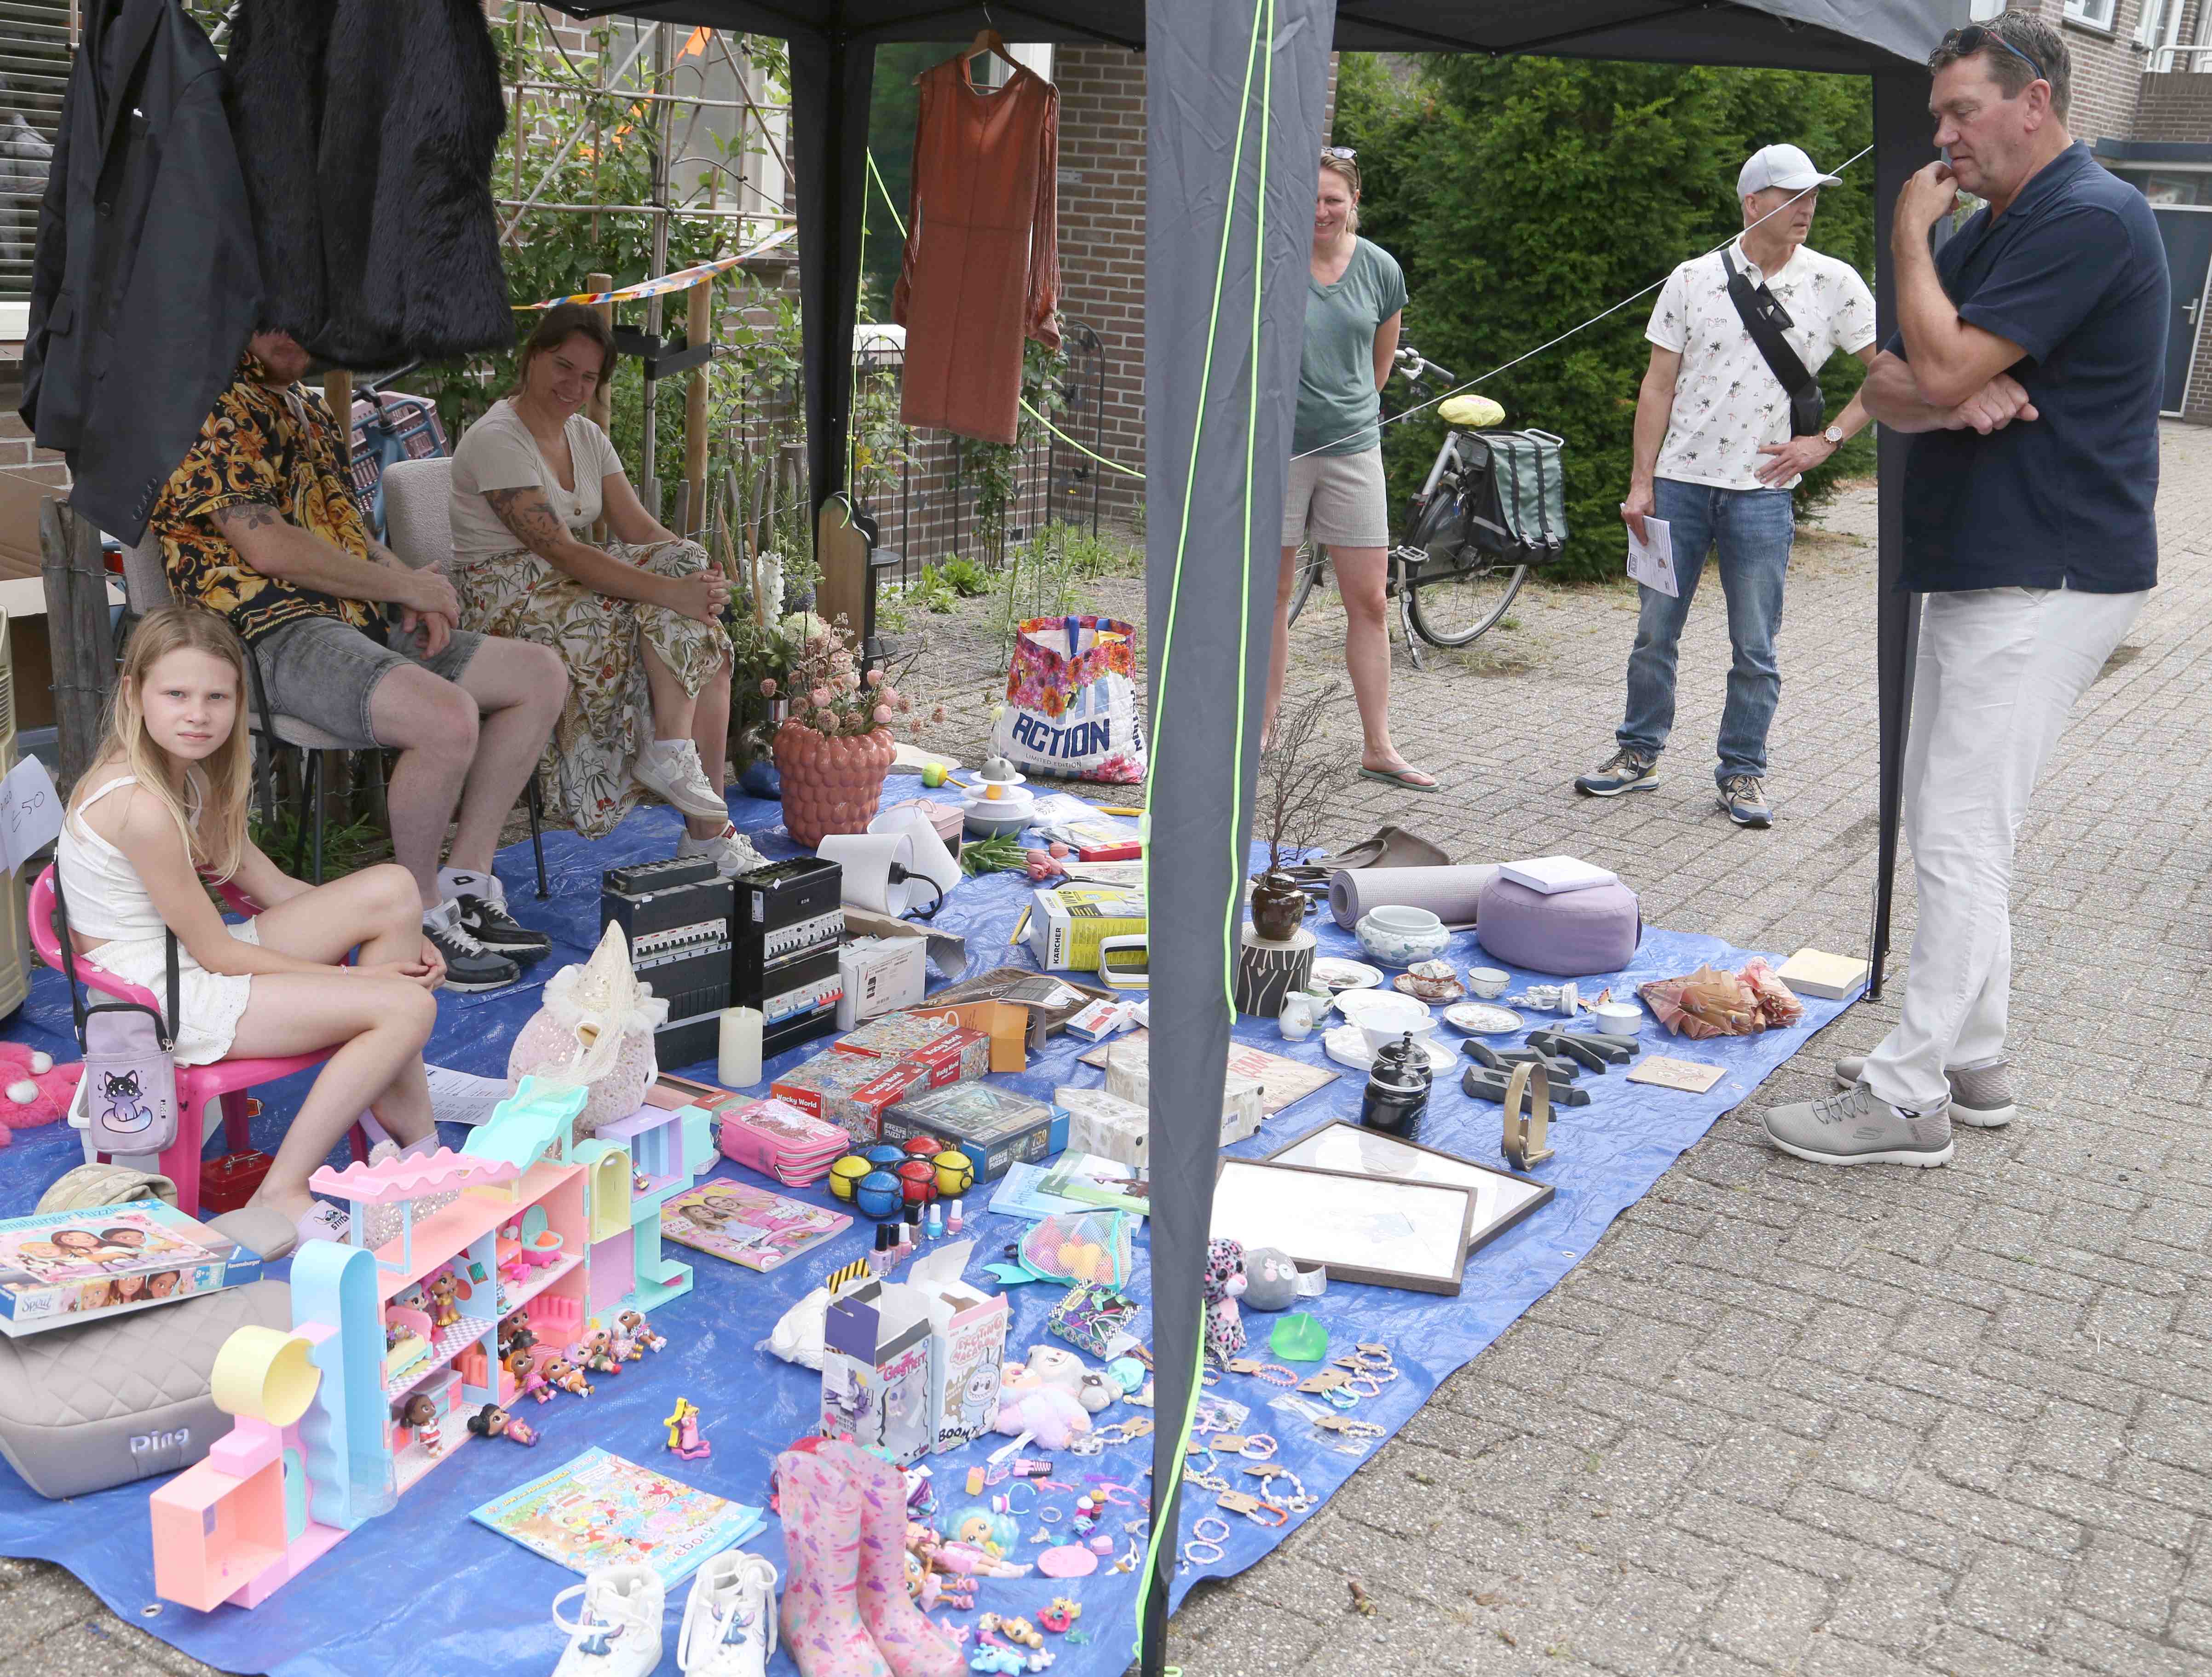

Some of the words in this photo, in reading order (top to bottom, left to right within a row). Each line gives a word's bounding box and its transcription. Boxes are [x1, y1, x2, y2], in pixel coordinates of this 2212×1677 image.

[1013, 712, 1110, 759] ACTION
[1026, 753, 1052, 765] LIMITED
[1054, 761, 1082, 769] EDITION
[936, 1067, 948, 1078] Wacky
[948, 1060, 959, 1071] World
[776, 1093, 797, 1105] Wacky
[799, 1099, 817, 1108] World
[1032, 1129, 1047, 1147] 759
[75, 1207, 122, 1220] Puzzle
[227, 1259, 261, 1270] Ravensburger
[22, 1292, 54, 1312] Spirit
